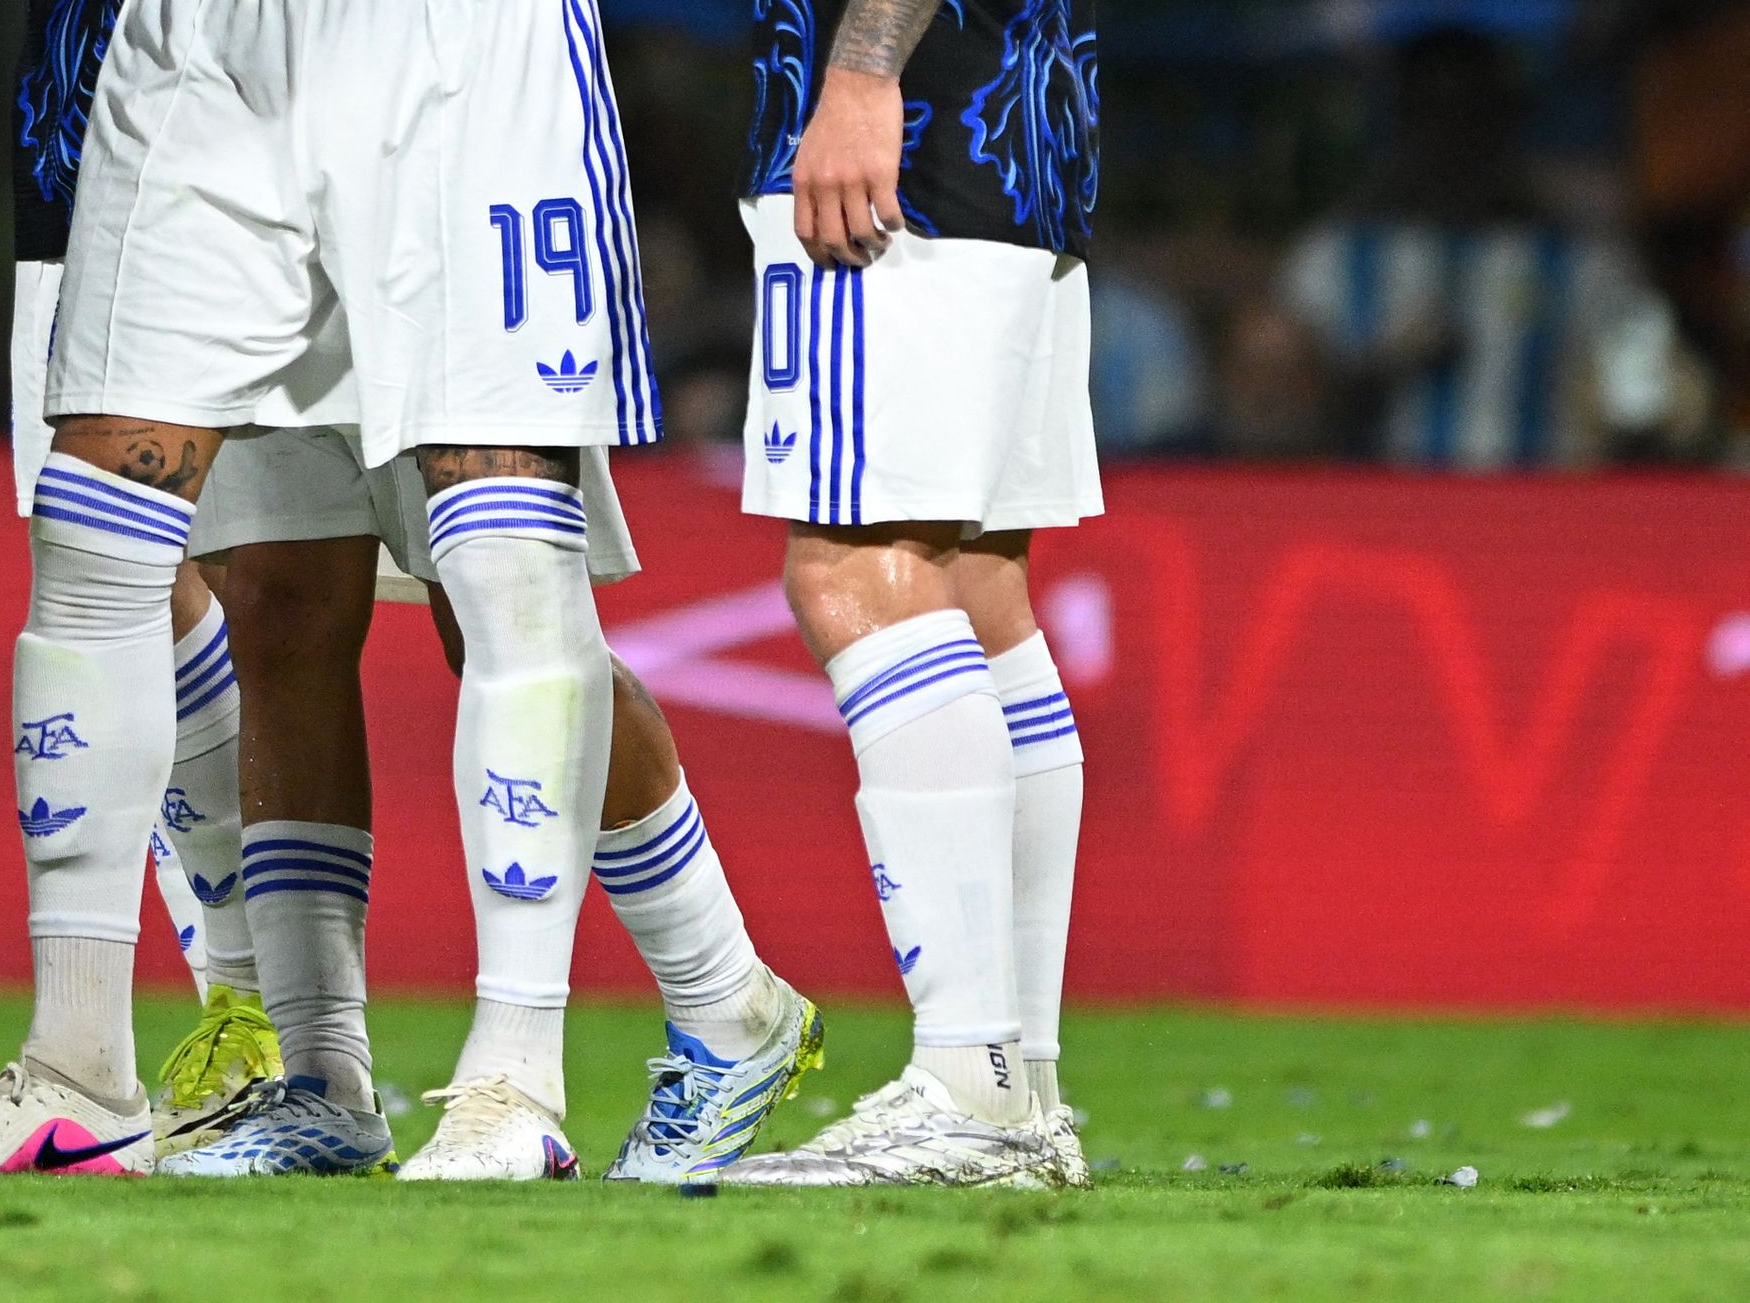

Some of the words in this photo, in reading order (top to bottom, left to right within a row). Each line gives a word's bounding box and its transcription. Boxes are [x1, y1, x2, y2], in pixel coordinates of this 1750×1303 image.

[489, 197, 596, 333] 19
[15, 712, 89, 761] AFA
[160, 787, 206, 833] FA
[479, 768, 559, 827] AFA
